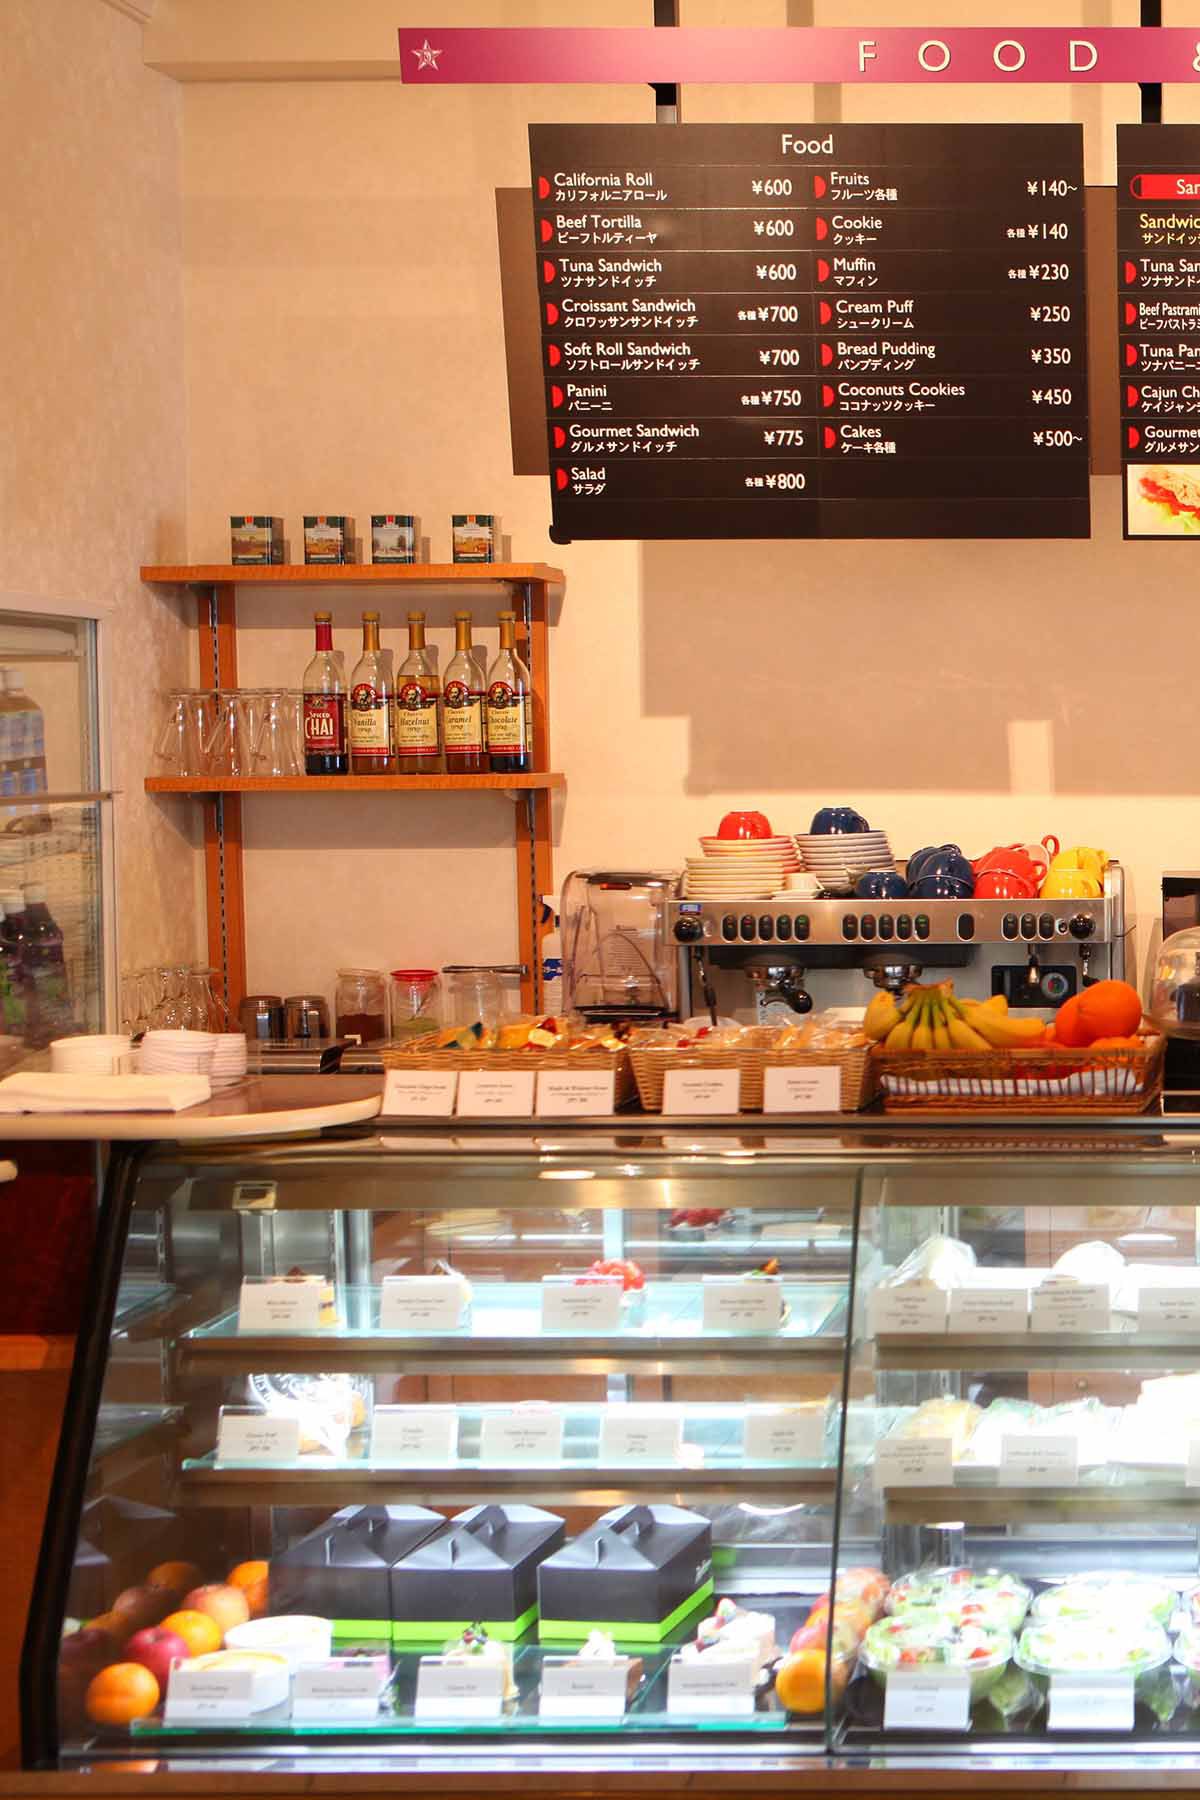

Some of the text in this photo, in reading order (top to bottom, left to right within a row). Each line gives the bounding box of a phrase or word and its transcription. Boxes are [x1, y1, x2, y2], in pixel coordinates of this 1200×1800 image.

[858, 40, 1098, 72] FOOD
[782, 134, 833, 153] Food
[555, 173, 652, 186] California Roll
[831, 172, 869, 185] Fruits
[752, 179, 792, 195] ¥600
[556, 190, 667, 201] カリフォルニアロール
[557, 215, 642, 228] Beef Tortilla
[832, 216, 882, 228] Cookie
[834, 234, 876, 245] クッキー
[559, 259, 662, 272] Tuna Sandwich
[834, 258, 875, 270] Muffin
[1140, 259, 1174, 272] Tuna
[561, 276, 656, 287] ツナサンドイッチ
[834, 276, 878, 286] マフィン
[562, 299, 695, 312] Croissant Sandwich
[836, 300, 913, 313] Cream Puff
[1140, 303, 1160, 315] Beef
[1163, 303, 1200, 315] Pastrami
[1031, 306, 1070, 321] ¥250
[565, 316, 698, 328] クロワッサンサンドイッチ
[838, 318, 914, 328] シュークリーム
[565, 343, 690, 355] Soft Roll Sandwich
[838, 342, 935, 358] Bread Pudding
[1140, 344, 1173, 357] Tuna
[760, 350, 799, 365] ¥700
[1032, 348, 1070, 364] ¥350
[567, 359, 700, 370] ソフトロールサンドイッチ
[568, 384, 606, 397] Panini
[839, 383, 965, 395] Coconuts Cookies
[1141, 386, 1177, 401] Cajun
[1032, 389, 1071, 404] ¥450
[840, 400, 935, 411] ココナッツクッキー
[570, 424, 699, 437] Gourmet Sandwich
[841, 425, 881, 438] Cakes
[764, 430, 803, 445] ¥775
[571, 441, 677, 452] グルメサンドイッチ
[572, 467, 605, 480] Salad
[573, 483, 606, 494] サラダ
[446, 716, 471, 724] aramel
[304, 718, 334, 739] CHAI
